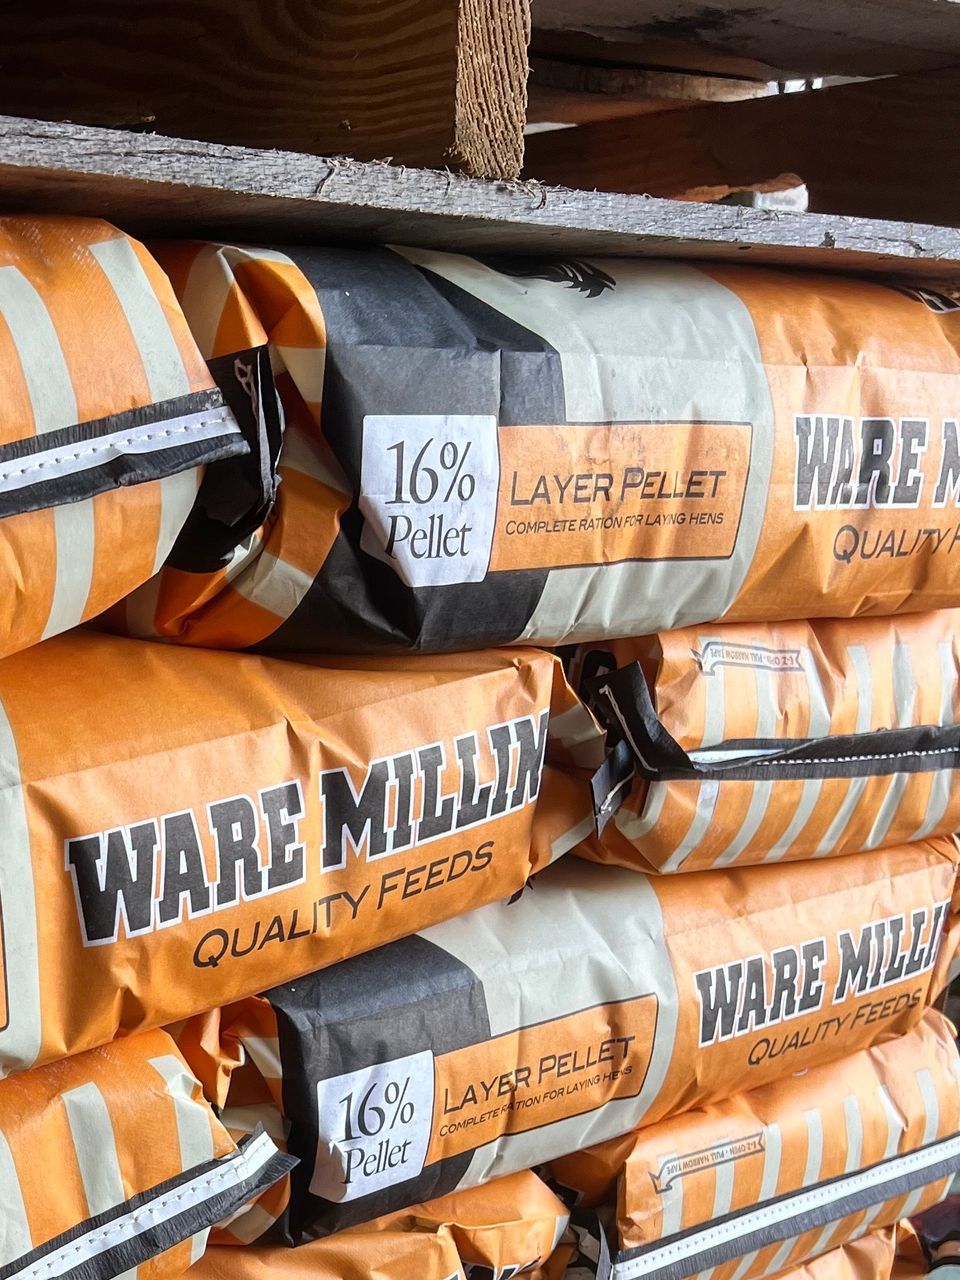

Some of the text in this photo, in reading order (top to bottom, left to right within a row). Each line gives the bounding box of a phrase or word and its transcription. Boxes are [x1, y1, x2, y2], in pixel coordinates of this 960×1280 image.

[385, 437, 476, 506] 16%
[510, 466, 727, 506] LAYER PELLET
[794, 413, 929, 511] WARE
[387, 513, 473, 559] Pellet
[505, 511, 724, 536] COMPLETE RATION FOR LAYING HENS
[833, 524, 951, 564] QUALITY
[64, 778, 307, 948] WARE
[193, 841, 495, 969] QUALITY FEEDS
[692, 935, 827, 1049] WARE
[748, 988, 922, 1066] QUALITY FEEDS
[440, 1108, 499, 1137] COMPLETE
[542, 1087, 564, 1102] FOR
[566, 1075, 601, 1096] LAYING
[443, 1036, 635, 1115] LAYER PELLET
[337, 1077, 415, 1144] 16%
[341, 1137, 412, 1185] Pellet
